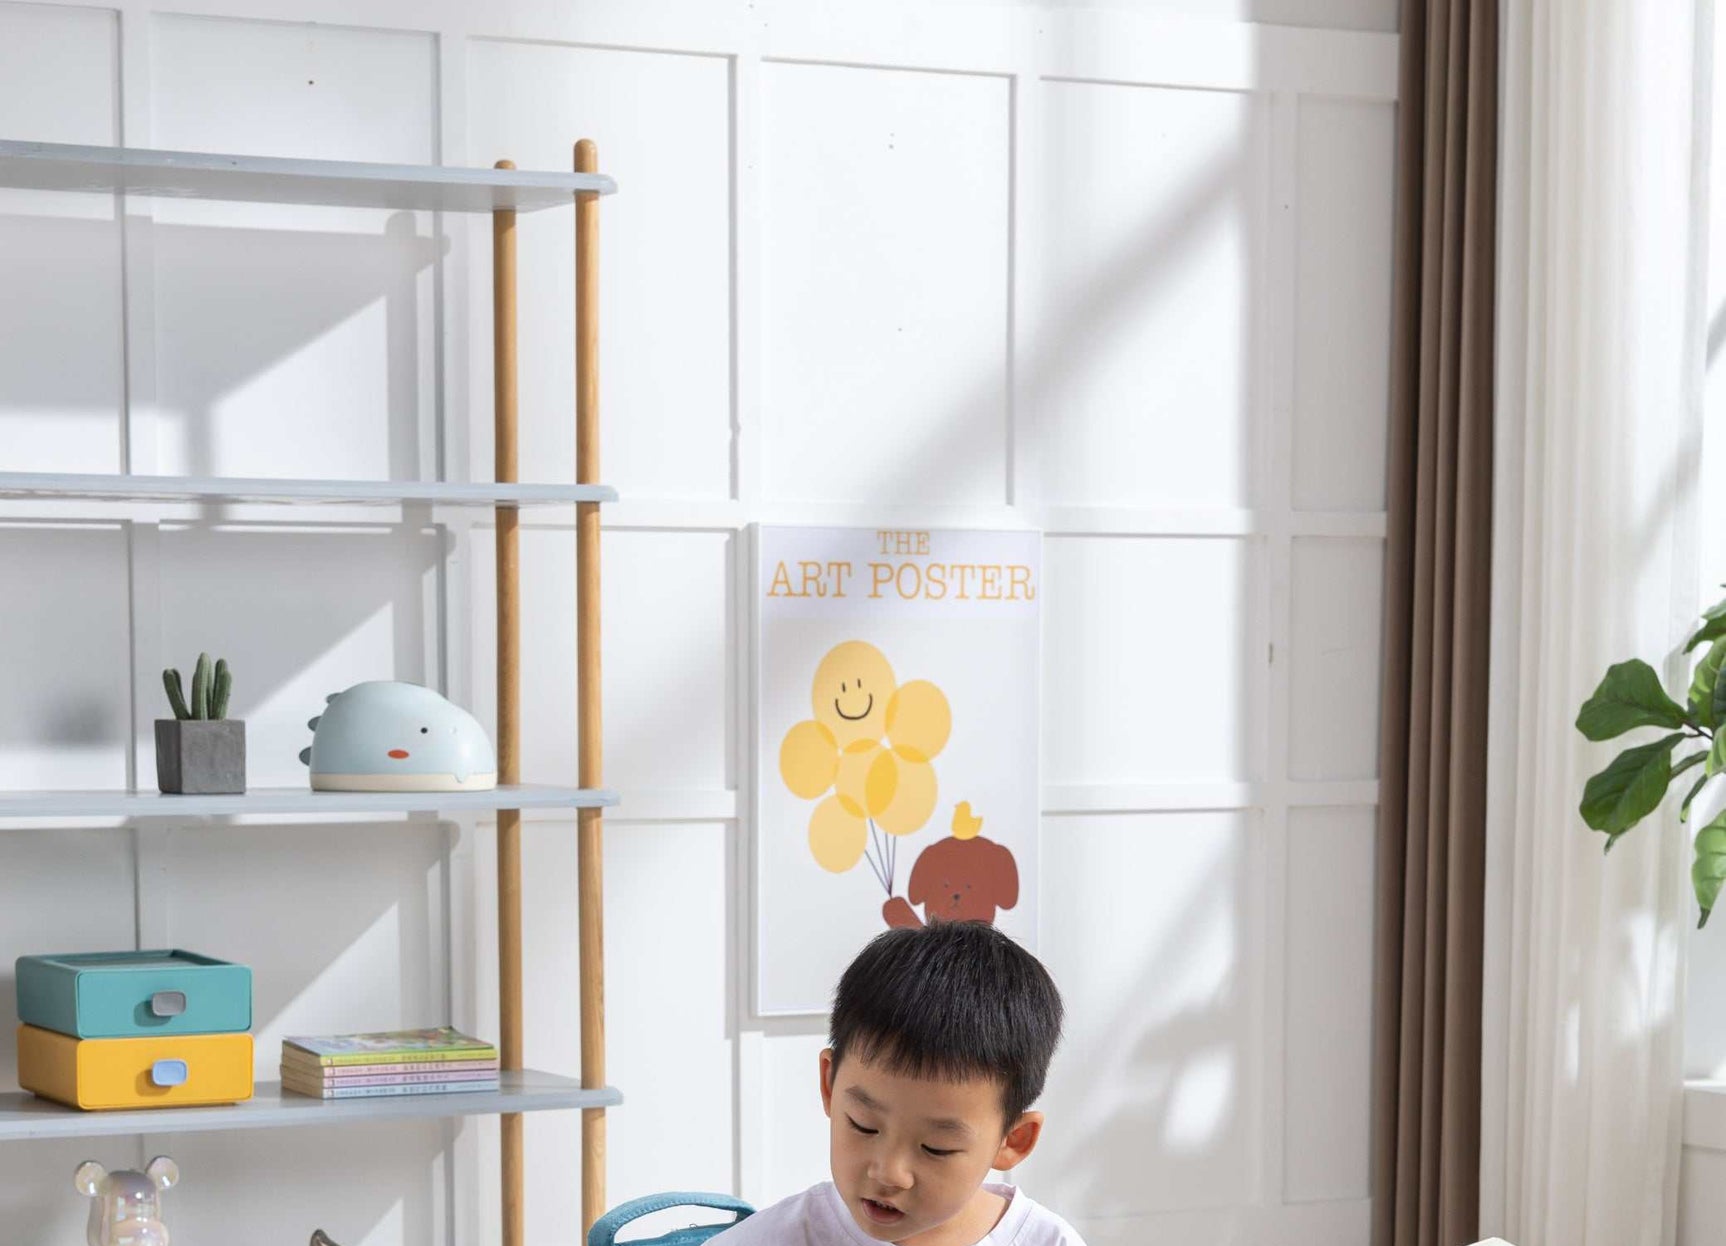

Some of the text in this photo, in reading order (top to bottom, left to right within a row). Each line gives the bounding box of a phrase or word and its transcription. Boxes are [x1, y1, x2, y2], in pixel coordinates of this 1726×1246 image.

[877, 530, 930, 555] THE
[767, 560, 1036, 601] ART POSTER
